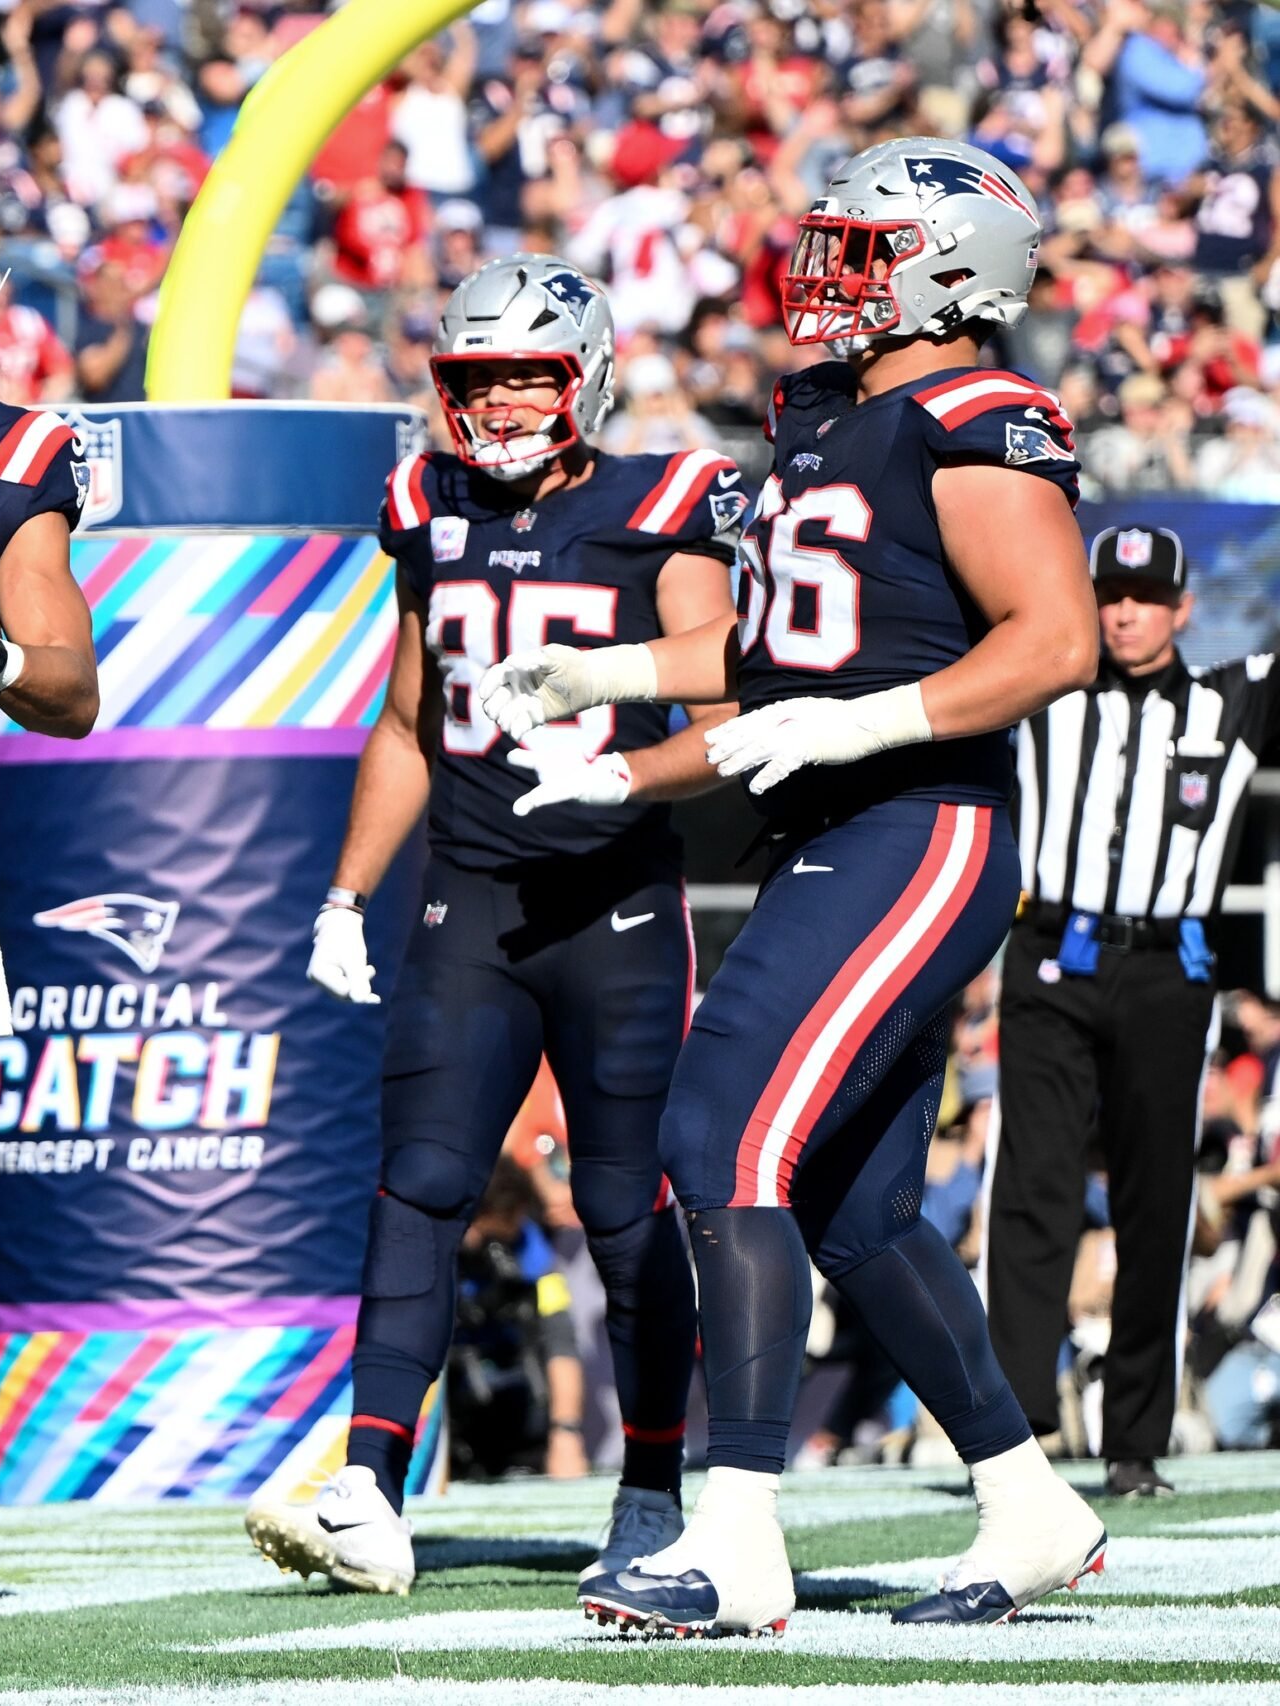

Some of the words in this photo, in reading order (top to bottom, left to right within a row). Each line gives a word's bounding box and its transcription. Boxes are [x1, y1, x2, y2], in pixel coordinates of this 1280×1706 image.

[426, 580, 618, 763] 85
[12, 981, 228, 1031] CRUCIAL
[127, 1136, 265, 1171] CANCER
